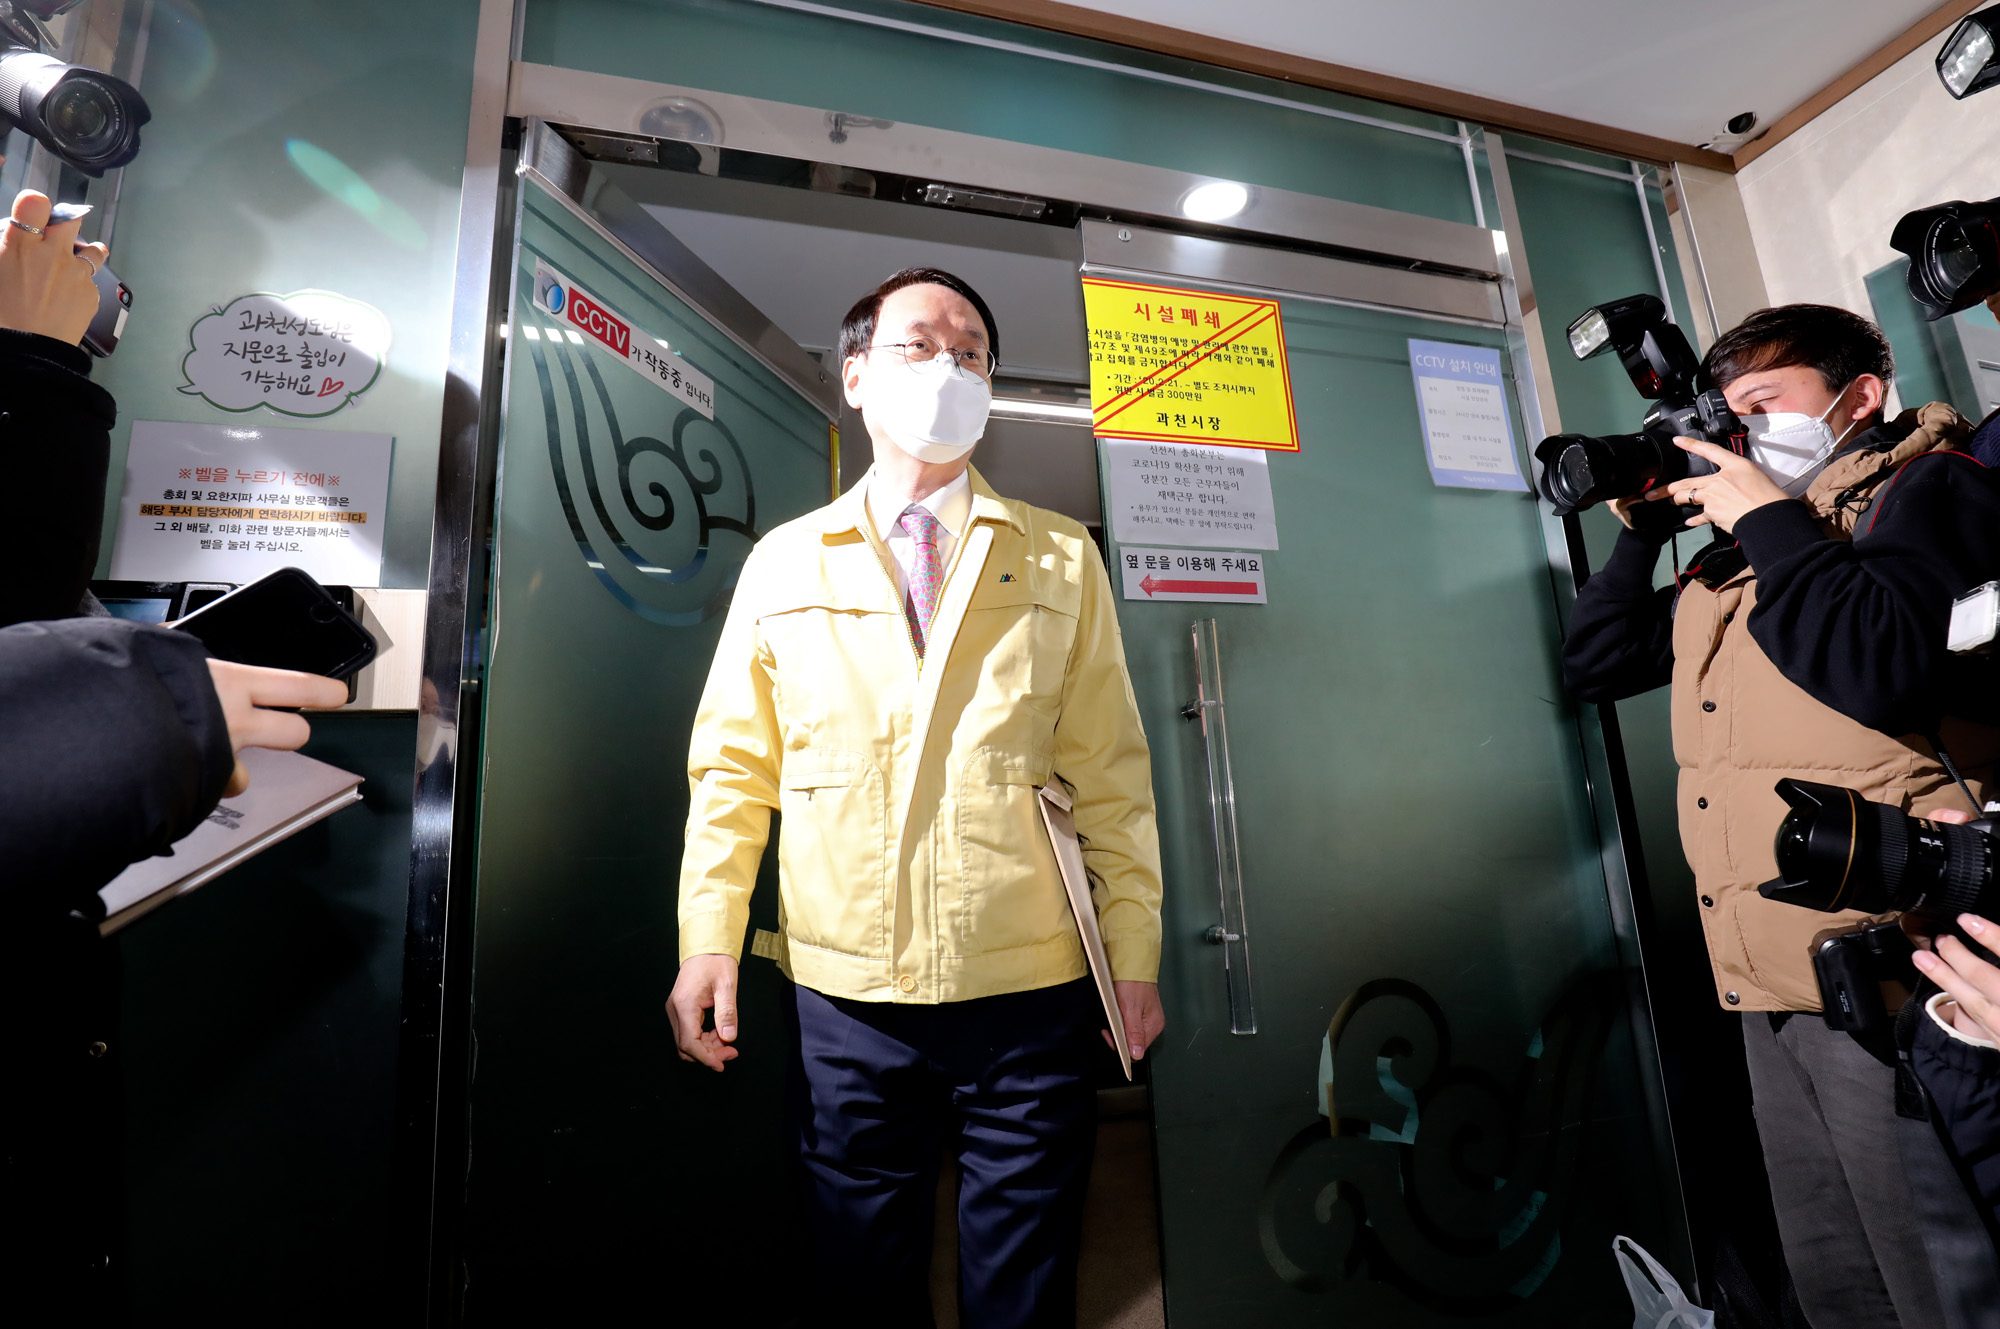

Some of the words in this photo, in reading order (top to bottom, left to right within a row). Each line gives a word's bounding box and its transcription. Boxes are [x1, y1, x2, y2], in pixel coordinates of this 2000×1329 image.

[12, 18, 38, 44] Canon
[1094, 328, 1122, 340] 시설을
[1170, 336, 1188, 347] 예방
[1232, 344, 1248, 354] 관한
[223, 341, 292, 364] 지문으로
[296, 341, 346, 369] 출입이
[573, 299, 627, 350] CCTV
[631, 345, 642, 362] 가
[644, 349, 682, 389] 작동중
[685, 381, 713, 409] 입니다.
[1107, 354, 1136, 364] 집회를
[1121, 343, 1130, 353] 및
[1134, 345, 1178, 358] 제49조에
[1236, 356, 1253, 365] 같이
[1257, 358, 1275, 368] 폐쇄
[1415, 354, 1445, 369] CCTV
[1449, 359, 1471, 374] 설치
[1473, 361, 1497, 377] 안내
[241, 371, 315, 396] 가능해요
[1114, 374, 1131, 384] 기간
[1193, 381, 1210, 391] 별도
[1213, 383, 1256, 396] 조치시까지
[1167, 390, 1203, 402] 300만원
[1150, 445, 1176, 456] 신천지
[1181, 448, 1225, 460] 총회본부는
[1131, 459, 1170, 470] 코로나19
[1174, 462, 1201, 473] 확산을
[1205, 464, 1223, 475] 막기
[1227, 466, 1245, 477] 위해
[235, 469, 286, 486] 누르기
[1141, 474, 1168, 485] 당분간
[1174, 478, 1191, 487] 모든
[1195, 478, 1240, 491] 근무자들이
[163, 489, 187, 500] 총회
[191, 490, 202, 501] 및
[206, 491, 253, 503] 요한지파
[256, 493, 290, 505] 사무실
[295, 494, 350, 507] 방문객들은
[1158, 491, 1194, 502] 재택근무
[1198, 493, 1228, 504] 합니다.
[141, 504, 165, 516] 해당
[169, 505, 193, 516] 부서
[197, 506, 254, 518] 담당자에게
[258, 509, 314, 521] 연락하시기
[318, 511, 366, 523] 바랍니다.
[1138, 504, 1158, 513] 용무가
[1161, 506, 1181, 514] 있으신
[1185, 507, 1204, 517] 분들은
[1207, 509, 1239, 519] 개인적으로
[1242, 511, 1256, 520] 연락
[154, 522, 166, 531] 그
[170, 521, 182, 532] 외
[219, 524, 242, 534] 미화
[246, 524, 268, 535] 관련
[272, 525, 350, 538] 방문자들께서는
[1165, 517, 1186, 527] 택배는
[1189, 519, 1196, 527] 문
[1198, 520, 1211, 529] 앞에
[200, 539, 223, 550] 벨을
[227, 540, 250, 551] 눌러
[254, 541, 303, 552] 주십시오.
[1126, 554, 1139, 569] 옆
[1144, 555, 1171, 570] 문을
[1177, 557, 1216, 571] 이용해
[1221, 558, 1260, 572] 주세요
